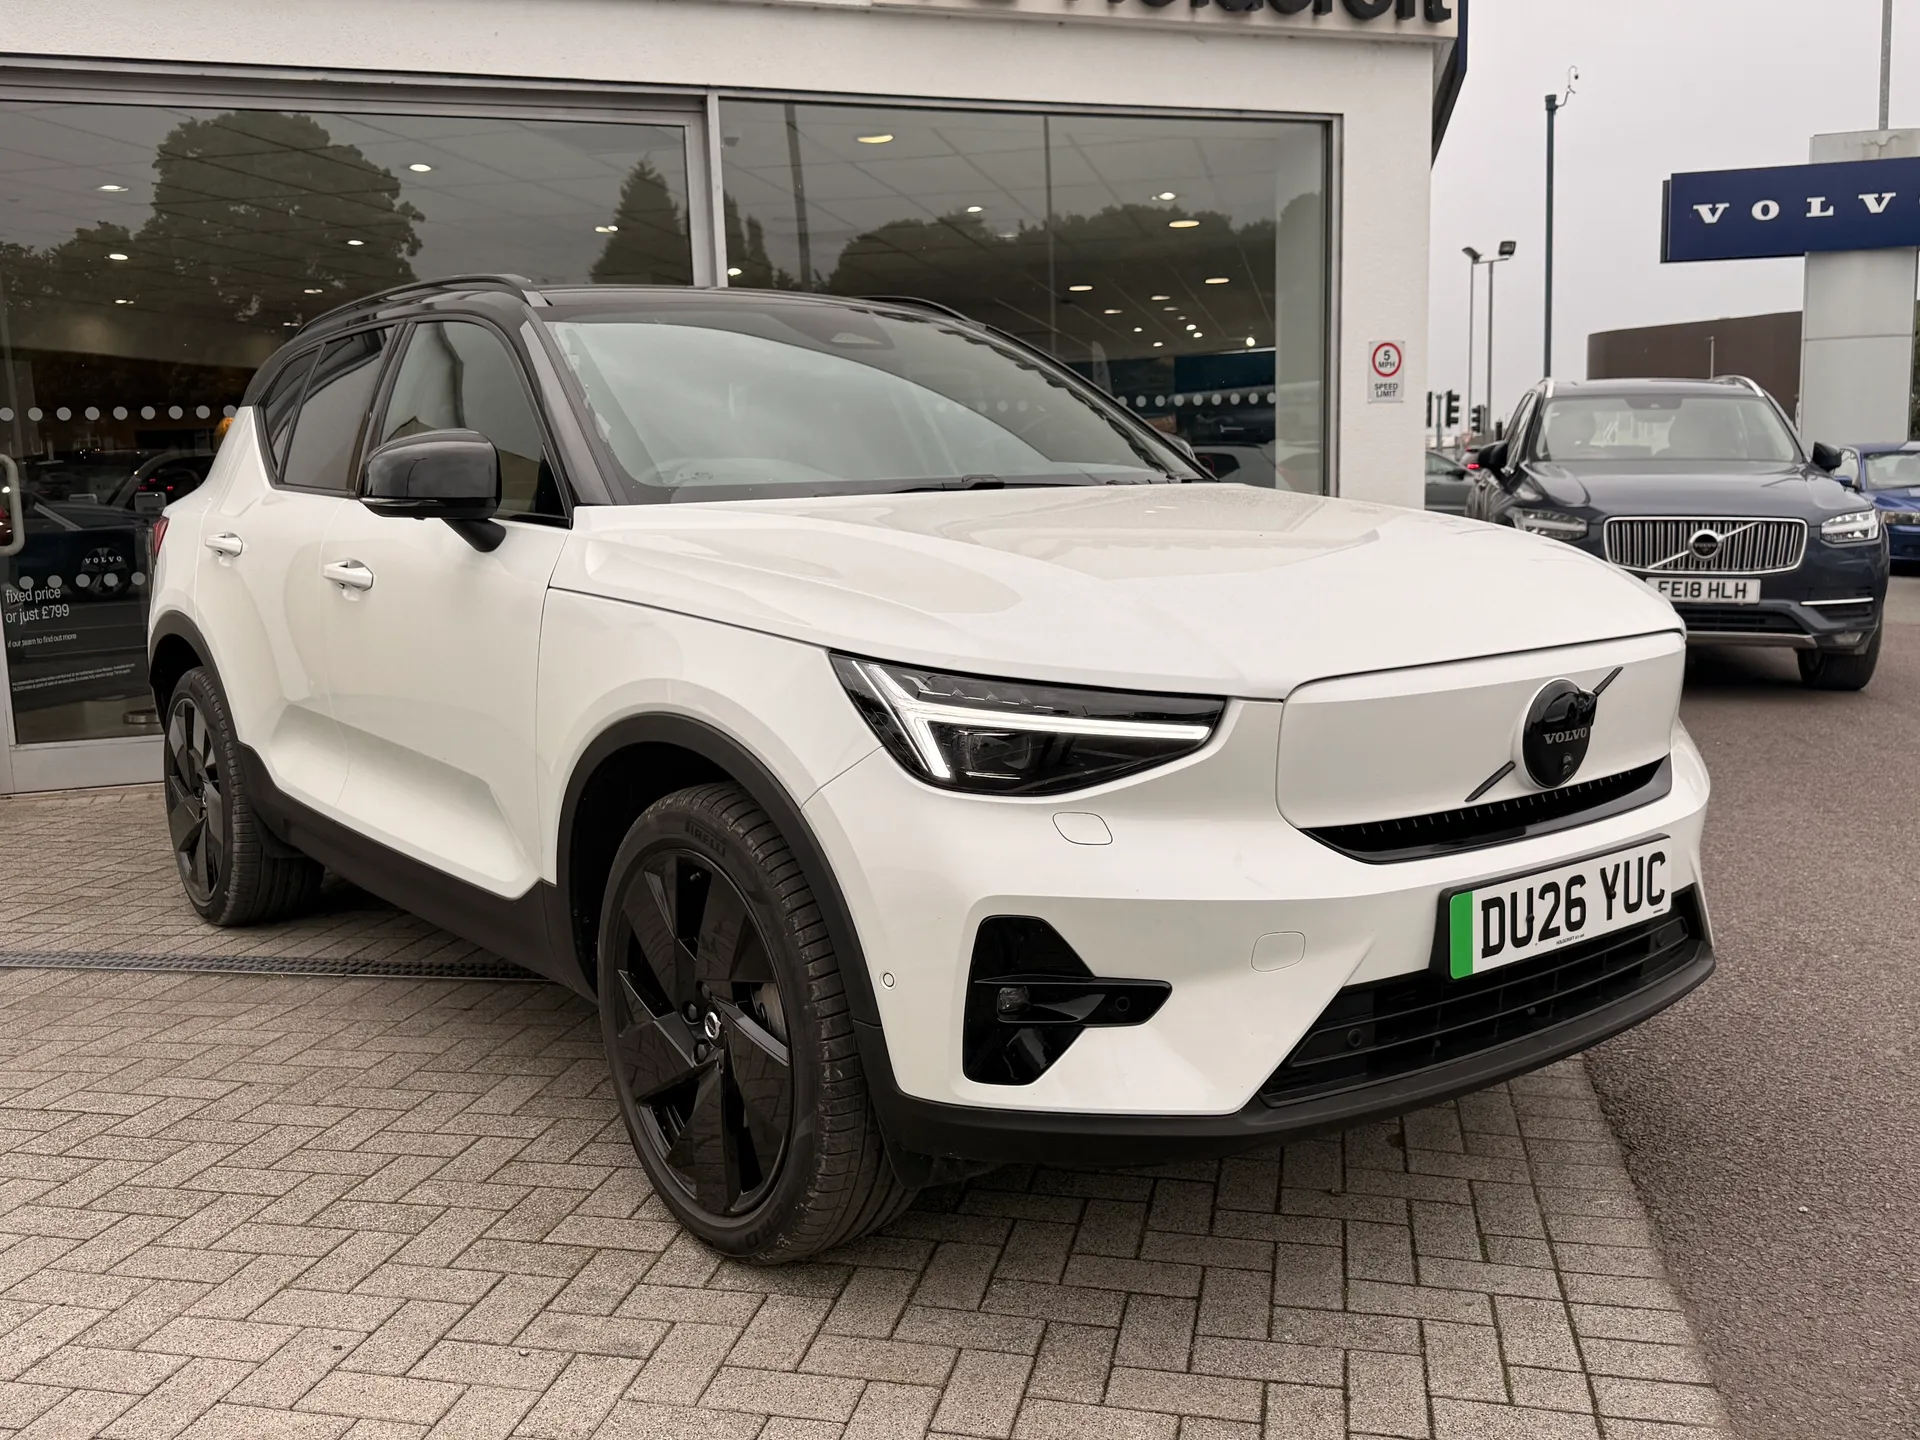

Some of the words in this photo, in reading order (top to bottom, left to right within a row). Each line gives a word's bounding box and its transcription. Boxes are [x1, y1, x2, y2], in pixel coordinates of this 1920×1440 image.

[1693, 192, 1920, 224] VOLV
[1383, 349, 1391, 361] 5
[1376, 390, 1396, 398] LIMIT
[84, 555, 122, 564] VOLVO
[5, 587, 33, 603] fixed
[34, 586, 61, 603] price
[1658, 580, 1702, 598] FE18
[1707, 582, 1747, 599] HLH
[4, 609, 17, 623] or
[19, 608, 40, 625] just
[41, 604, 70, 619] £799
[43, 635, 53, 643] find
[53, 634, 62, 642] out
[62, 633, 77, 641] more
[1543, 727, 1587, 744] VOLVO
[1481, 874, 1587, 959] DU26
[1600, 851, 1666, 921] YUC
